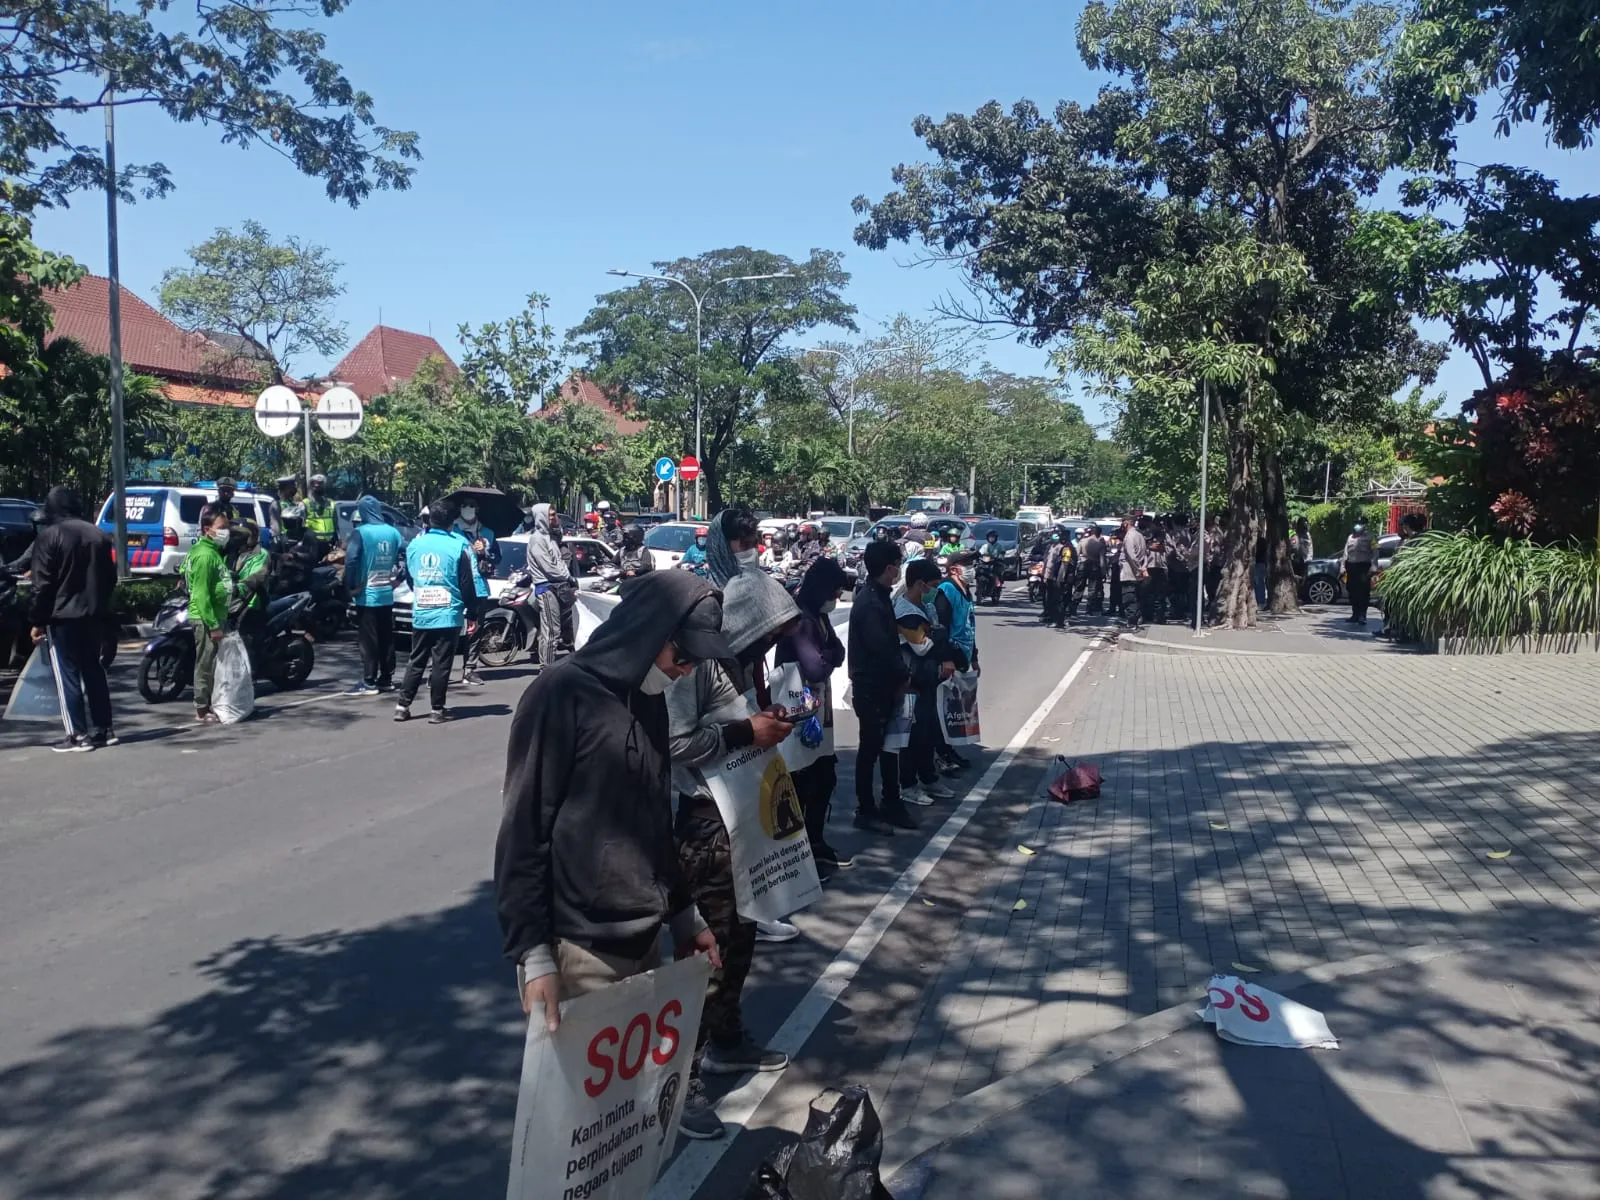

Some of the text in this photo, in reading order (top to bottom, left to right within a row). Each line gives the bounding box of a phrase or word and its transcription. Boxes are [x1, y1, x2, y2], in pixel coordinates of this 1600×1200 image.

[726, 747, 762, 771] condition
[748, 857, 764, 876] Kami
[780, 839, 806, 857] dengan
[750, 872, 766, 889] yang
[766, 862, 783, 877] tidak
[783, 853, 800, 870] pasti
[752, 883, 769, 900] yang
[583, 999, 683, 1098] SOS
[571, 1112, 604, 1148] Kami
[605, 1098, 635, 1129] minta
[565, 1122, 640, 1180] perpindahan
[641, 1112, 657, 1132] ke
[562, 1143, 643, 1200] negara tujuan
